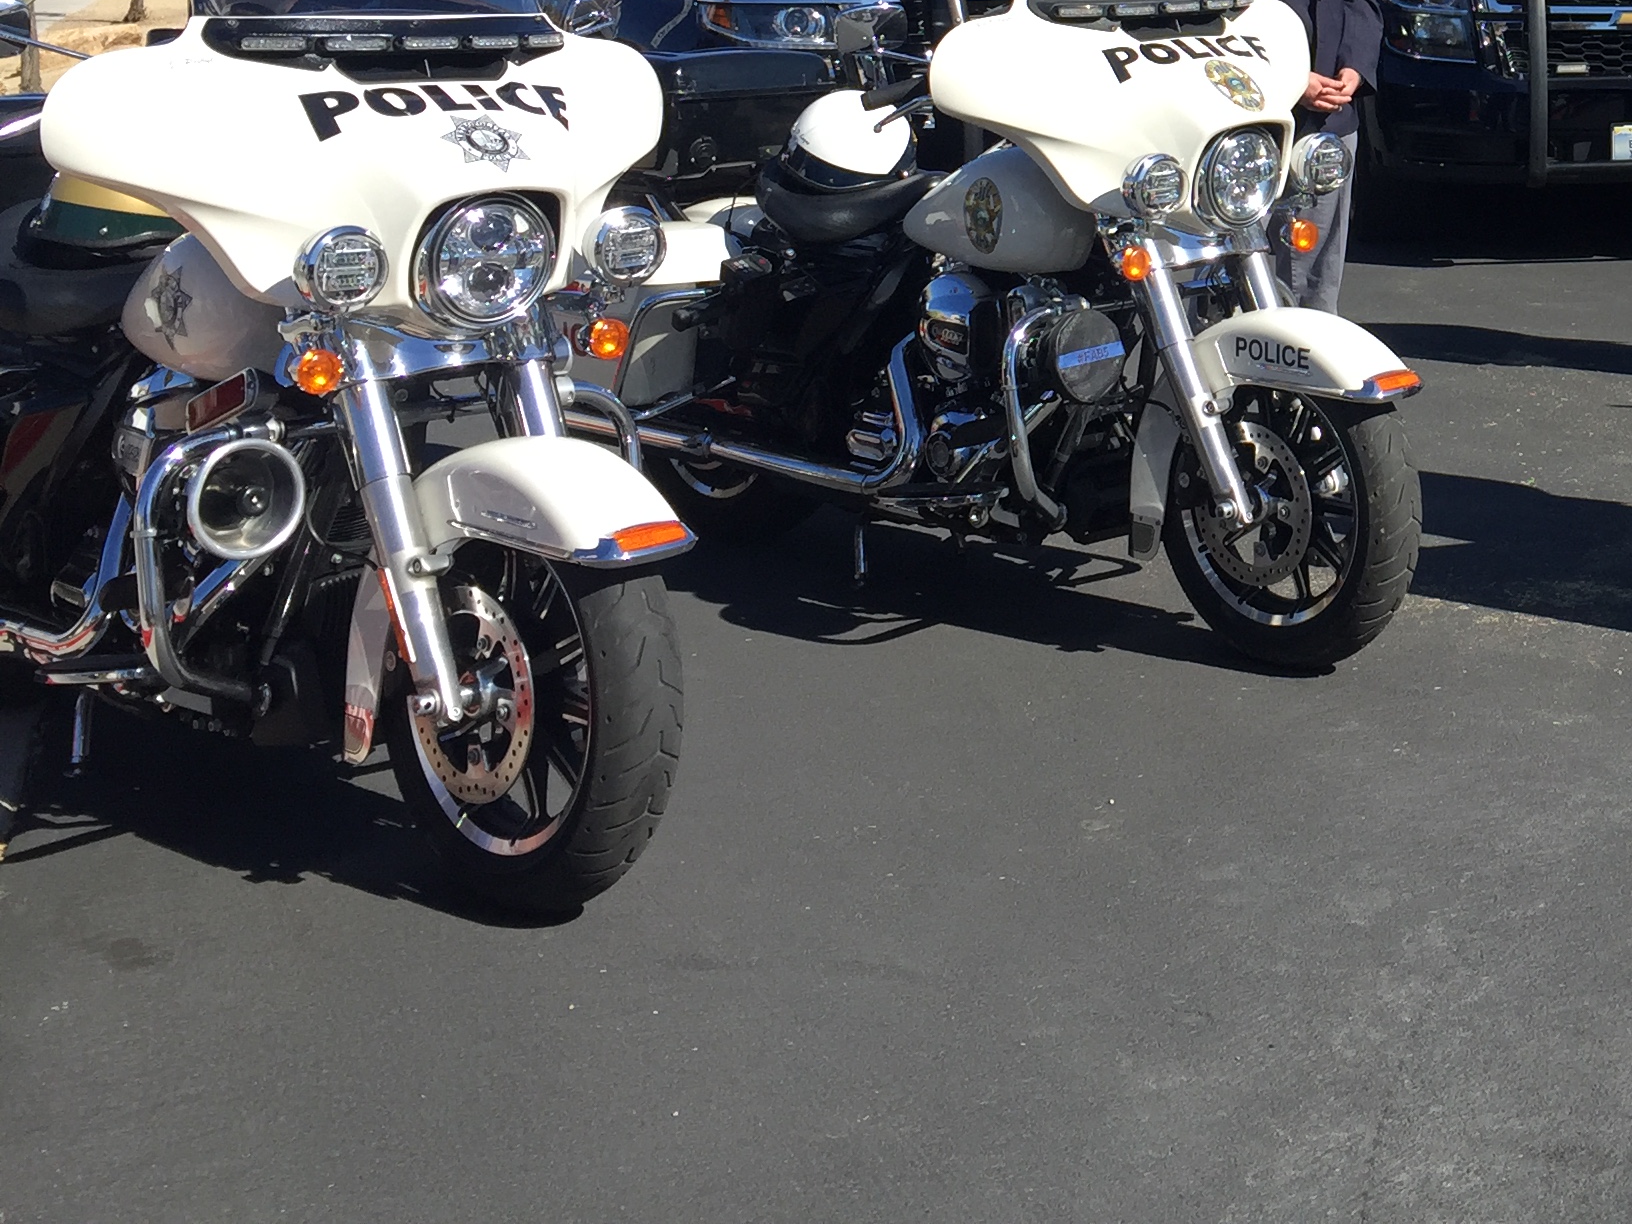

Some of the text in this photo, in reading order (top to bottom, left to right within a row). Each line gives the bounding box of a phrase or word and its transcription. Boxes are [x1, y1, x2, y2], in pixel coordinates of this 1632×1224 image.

[1101, 34, 1271, 84] POLICE
[298, 81, 570, 142] POLICE
[1235, 336, 1311, 370] POLICE
